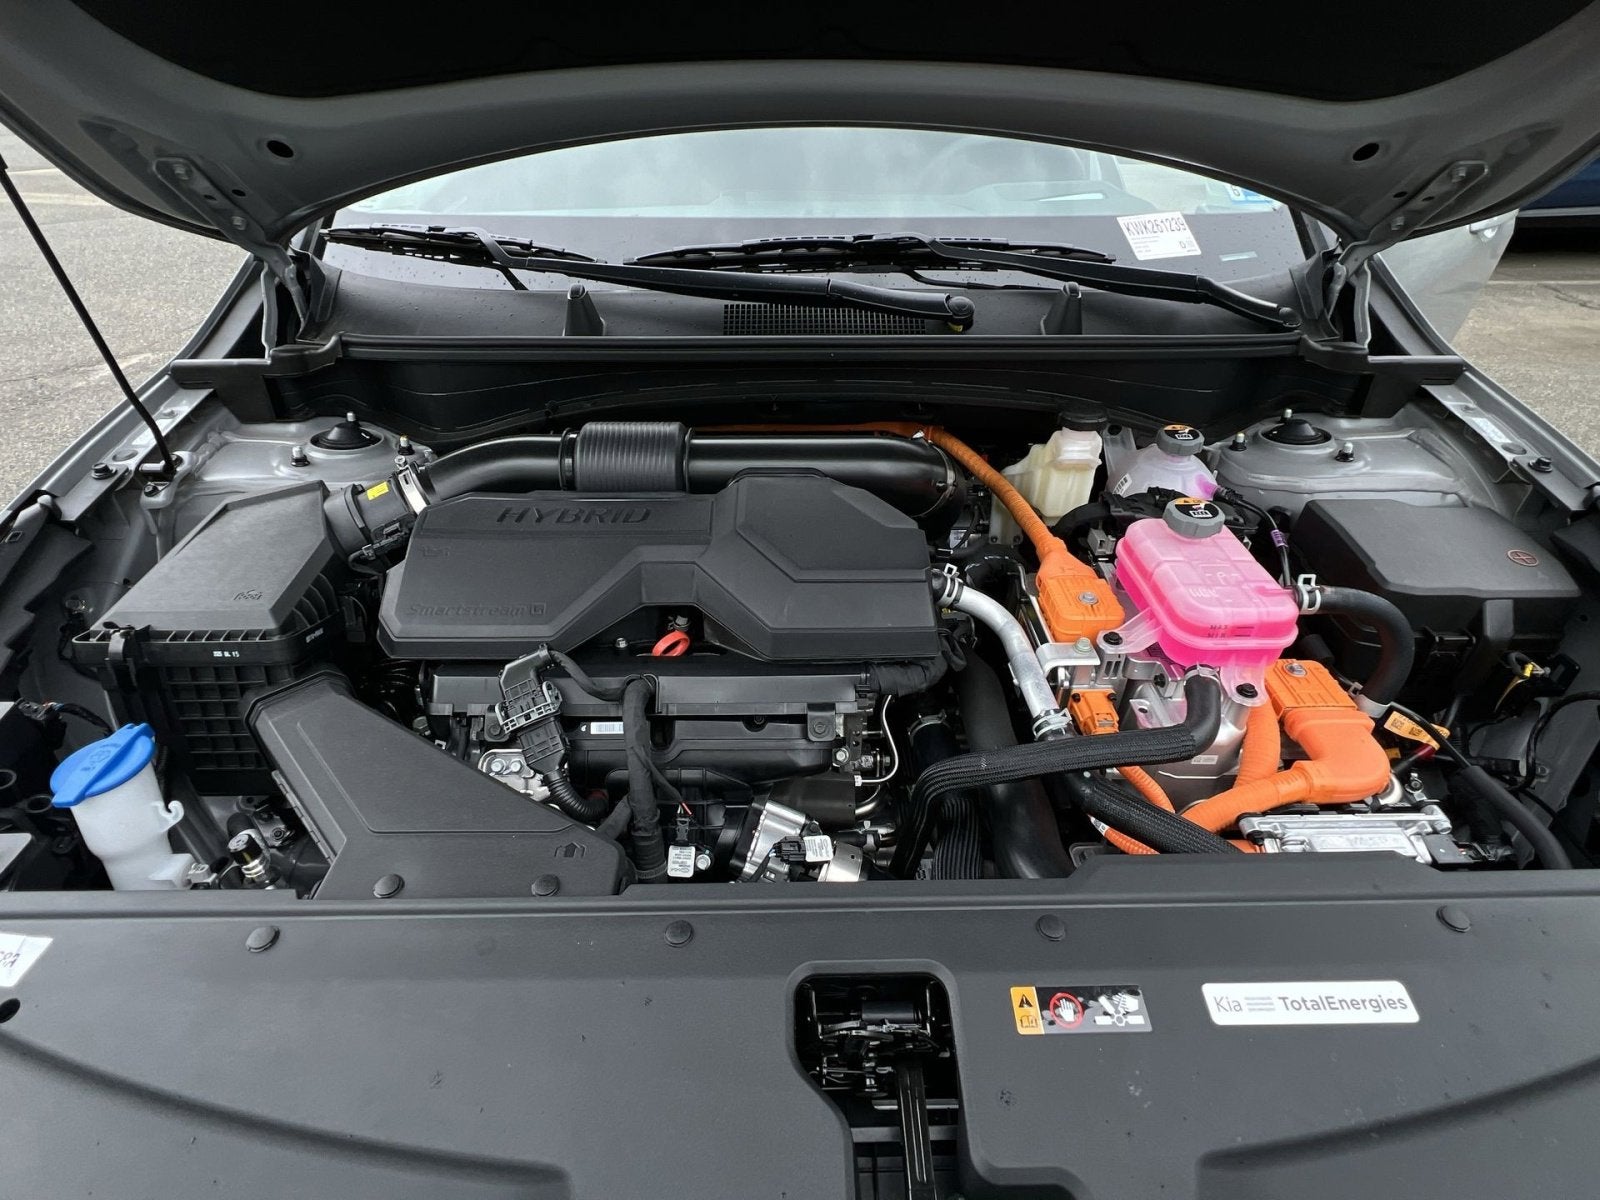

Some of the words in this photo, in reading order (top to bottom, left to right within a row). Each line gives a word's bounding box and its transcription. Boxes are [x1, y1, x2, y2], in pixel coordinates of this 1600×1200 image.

[1123, 218, 1187, 237] KWK261239
[496, 506, 651, 525] HYBRID
[407, 603, 526, 617] Smartstream
[1213, 996, 1243, 1013] Kia
[1278, 994, 1408, 1013] TotalEnergies
